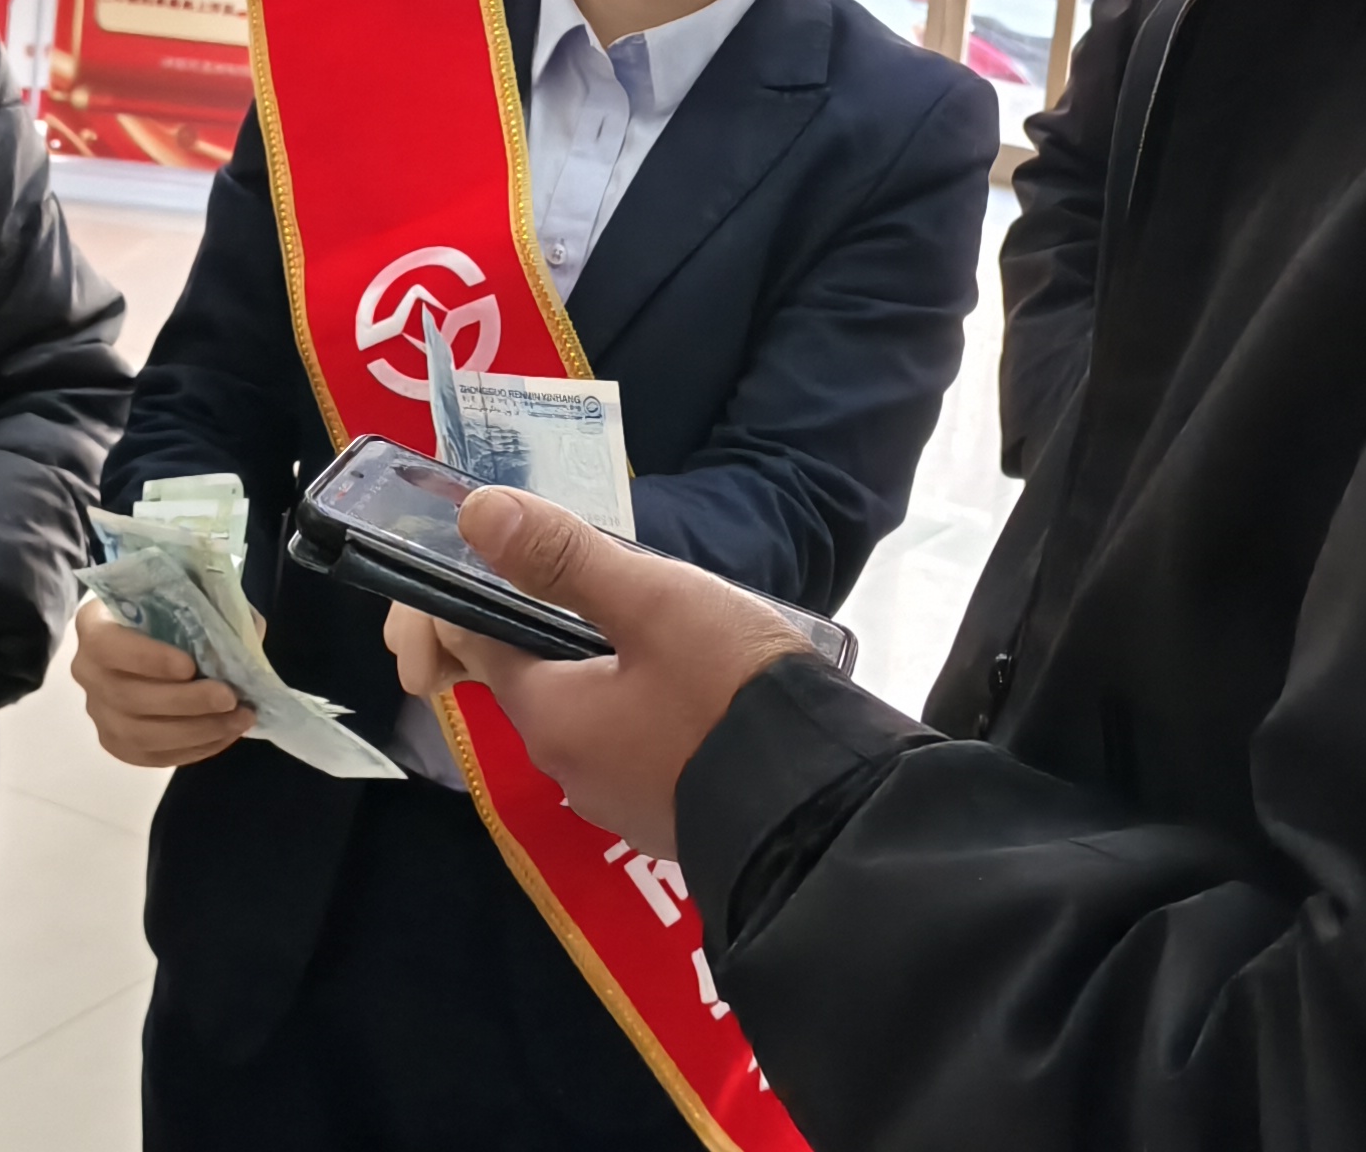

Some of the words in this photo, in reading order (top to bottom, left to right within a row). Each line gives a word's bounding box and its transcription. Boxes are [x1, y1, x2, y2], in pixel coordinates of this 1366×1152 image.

[459, 384, 507, 397] ZHONGGUO
[508, 389, 541, 401] RENMIN
[541, 392, 581, 405] YINHANG
